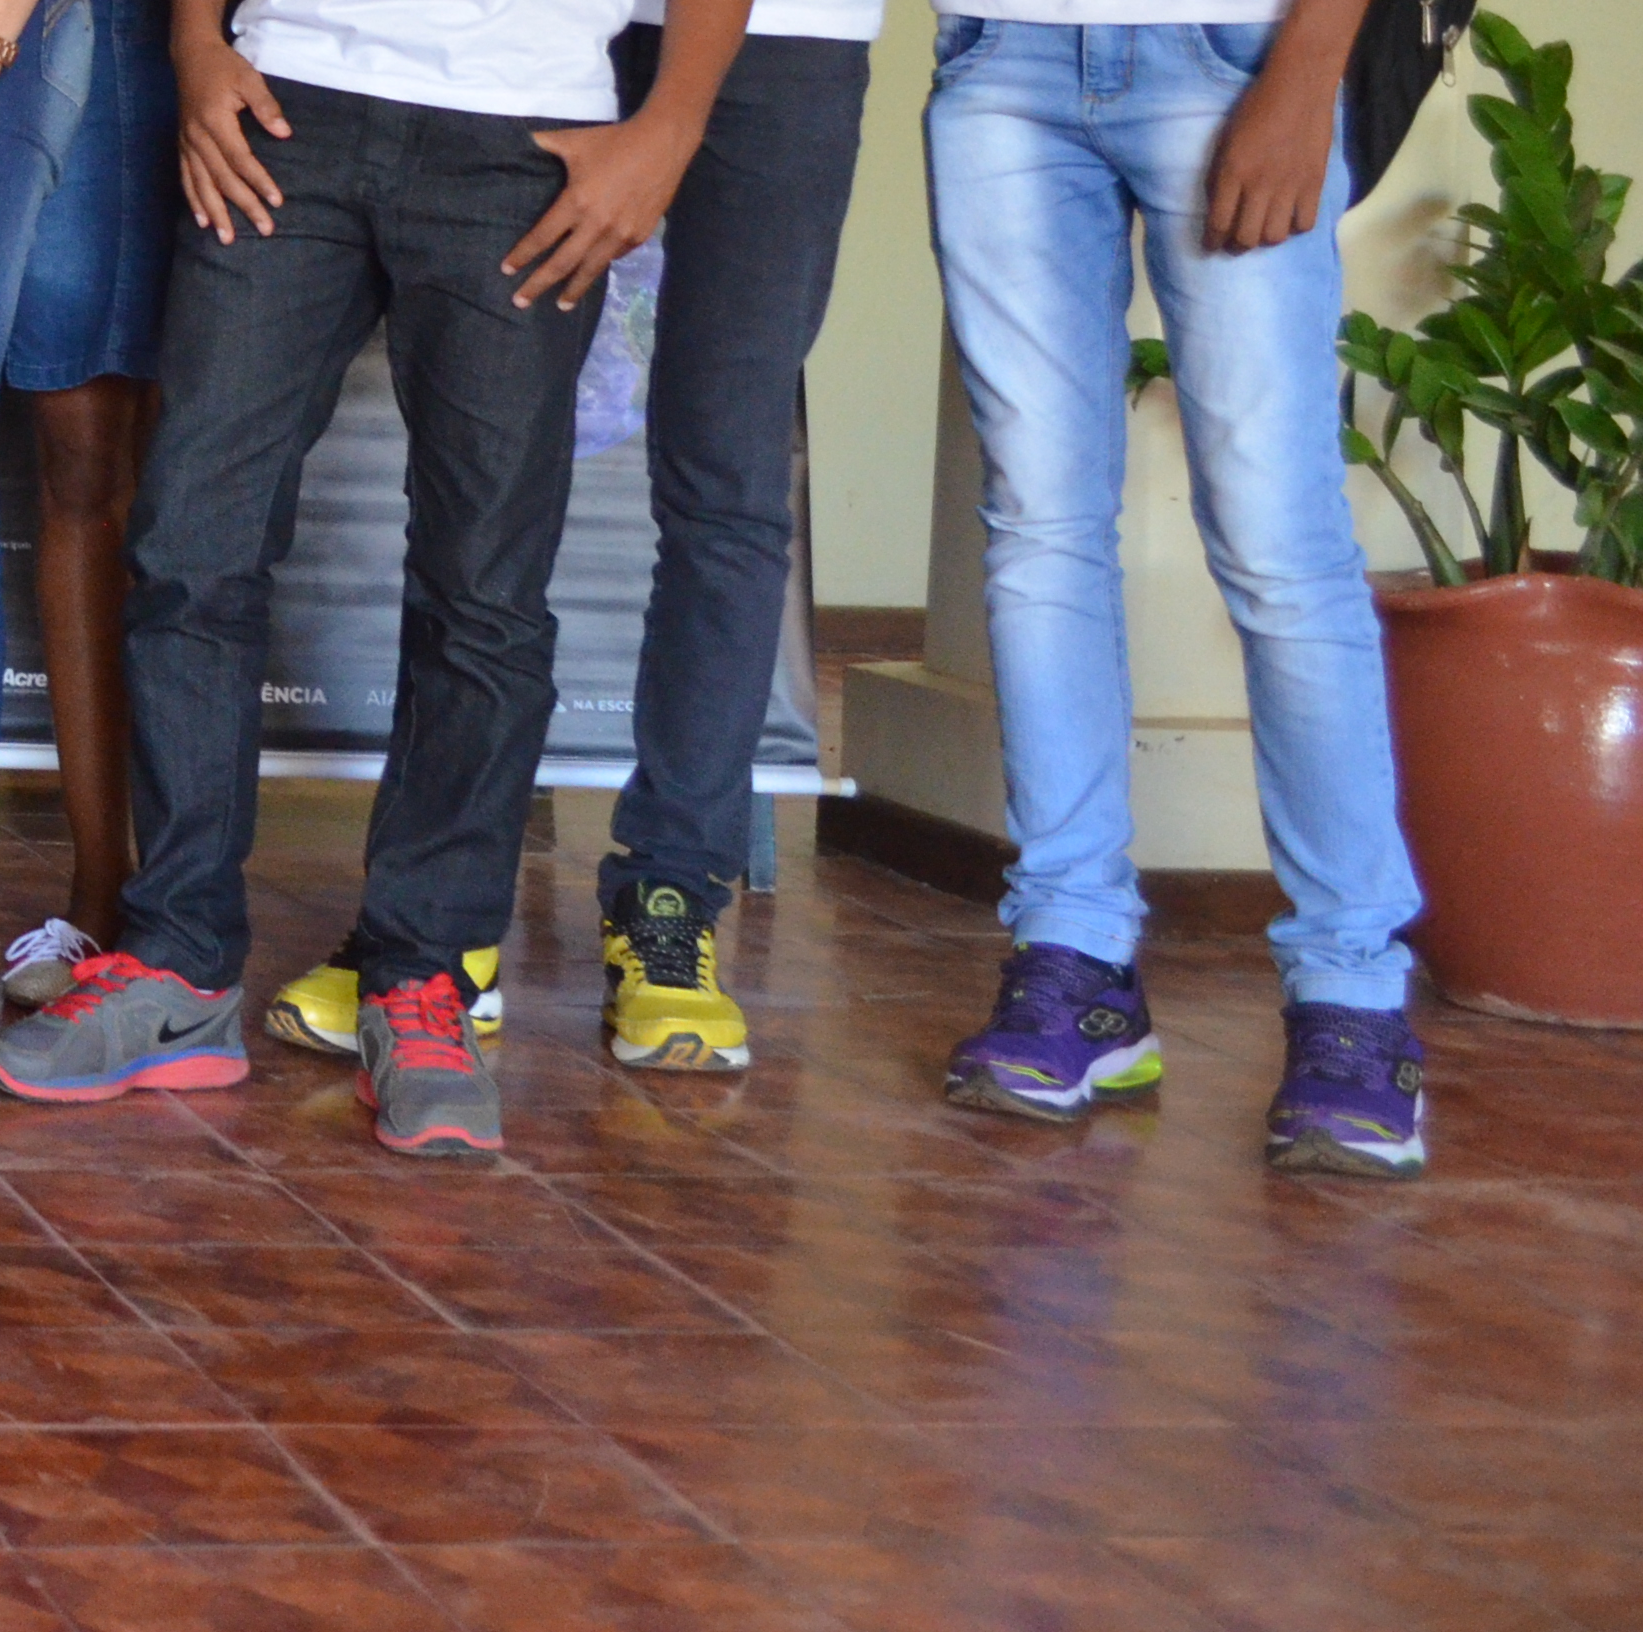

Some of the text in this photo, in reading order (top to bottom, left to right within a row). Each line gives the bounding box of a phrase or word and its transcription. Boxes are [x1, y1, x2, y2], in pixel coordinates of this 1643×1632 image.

[2, 668, 48, 688] Acre
[260, 682, 327, 705] ÊNCIA
[573, 700, 594, 711] NA
